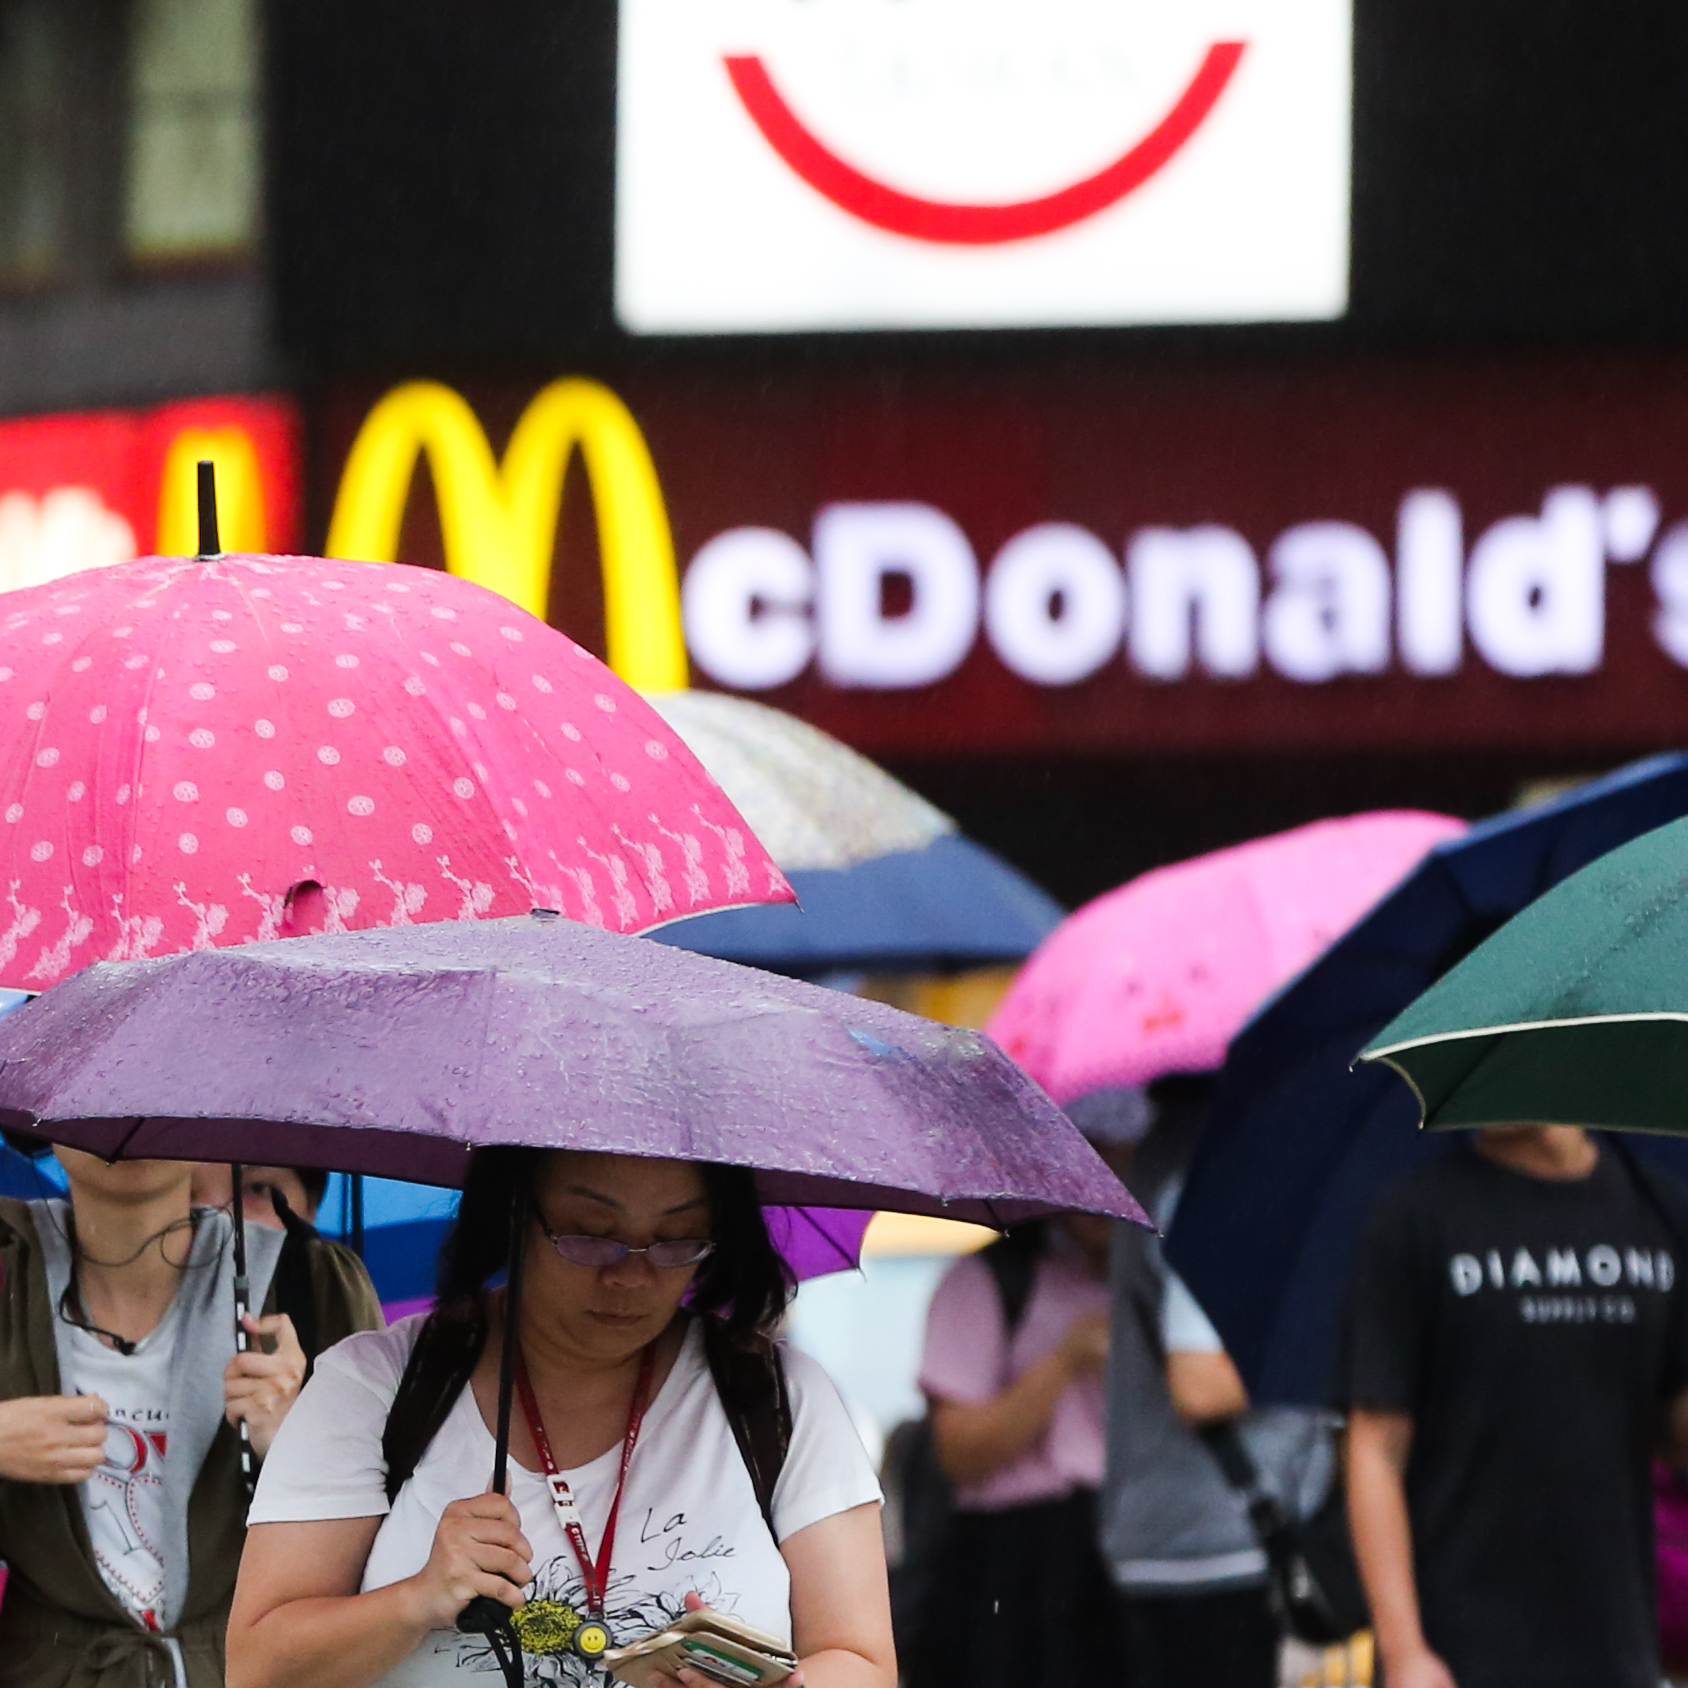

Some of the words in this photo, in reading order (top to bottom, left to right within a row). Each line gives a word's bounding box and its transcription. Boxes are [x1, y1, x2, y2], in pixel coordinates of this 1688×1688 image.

[1450, 1243, 1675, 1298] DIAMOND
[640, 1507, 687, 1543] La
[647, 1535, 736, 1571] Jolie
